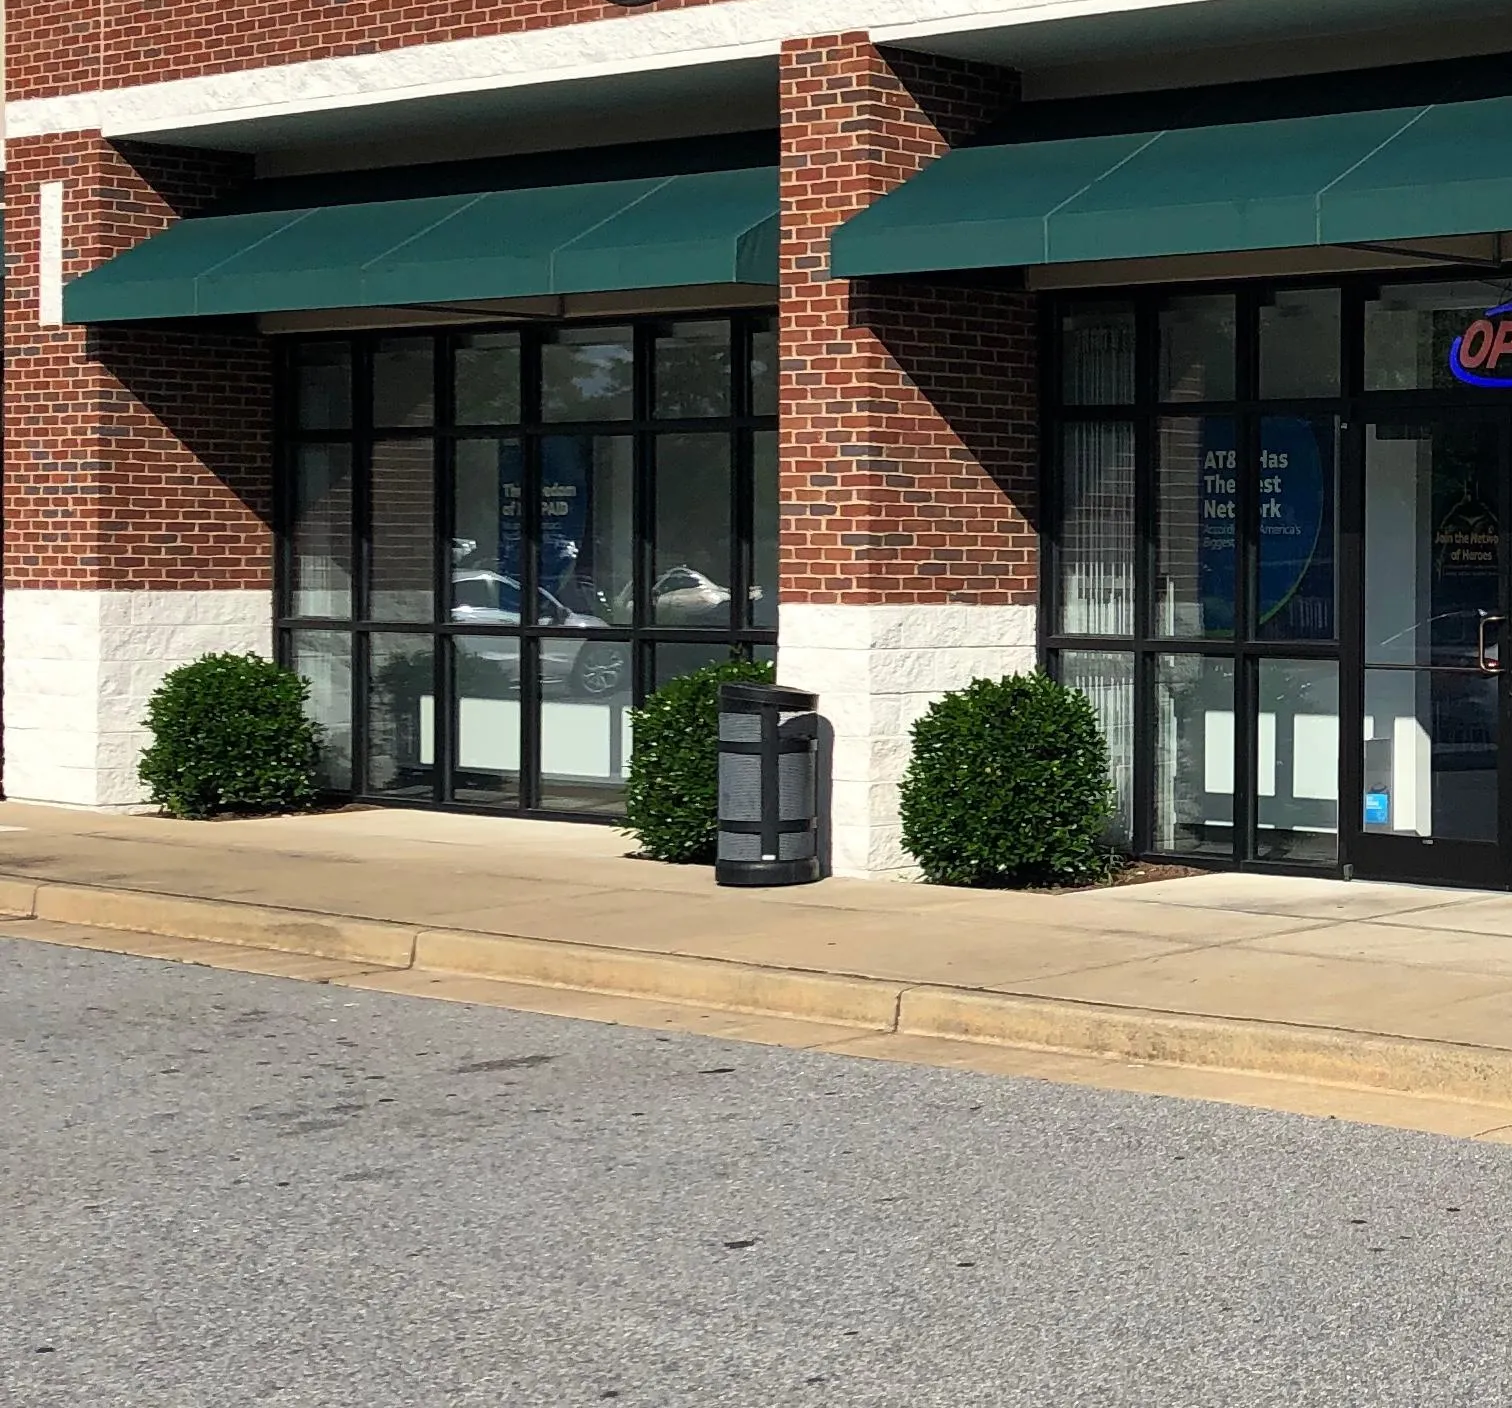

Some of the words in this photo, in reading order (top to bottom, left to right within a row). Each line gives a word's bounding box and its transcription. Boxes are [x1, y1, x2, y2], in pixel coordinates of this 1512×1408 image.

[1204, 450, 1236, 469] AT&
[1204, 474, 1236, 494] The
[1204, 498, 1282, 519] Netrk
[1470, 531, 1499, 545] Netwo
